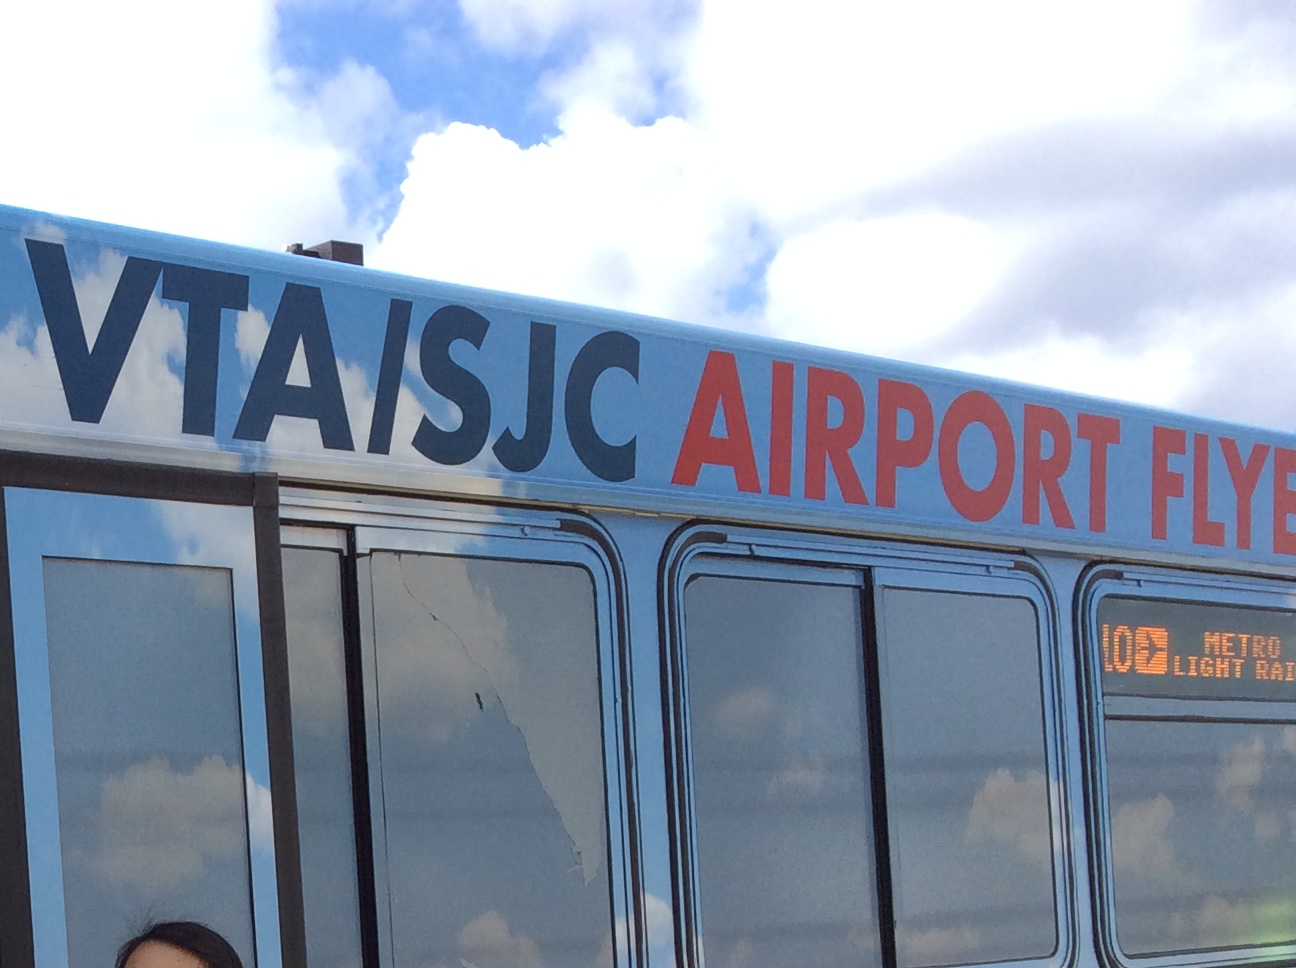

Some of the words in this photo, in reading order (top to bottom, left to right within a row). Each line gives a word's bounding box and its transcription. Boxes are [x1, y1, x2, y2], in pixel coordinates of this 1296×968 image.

[24, 237, 641, 483] VTA/SJC
[670, 348, 1122, 533] AIRPORT
[1204, 631, 1282, 660] METRO
[1173, 655, 1246, 679] LIGHT
